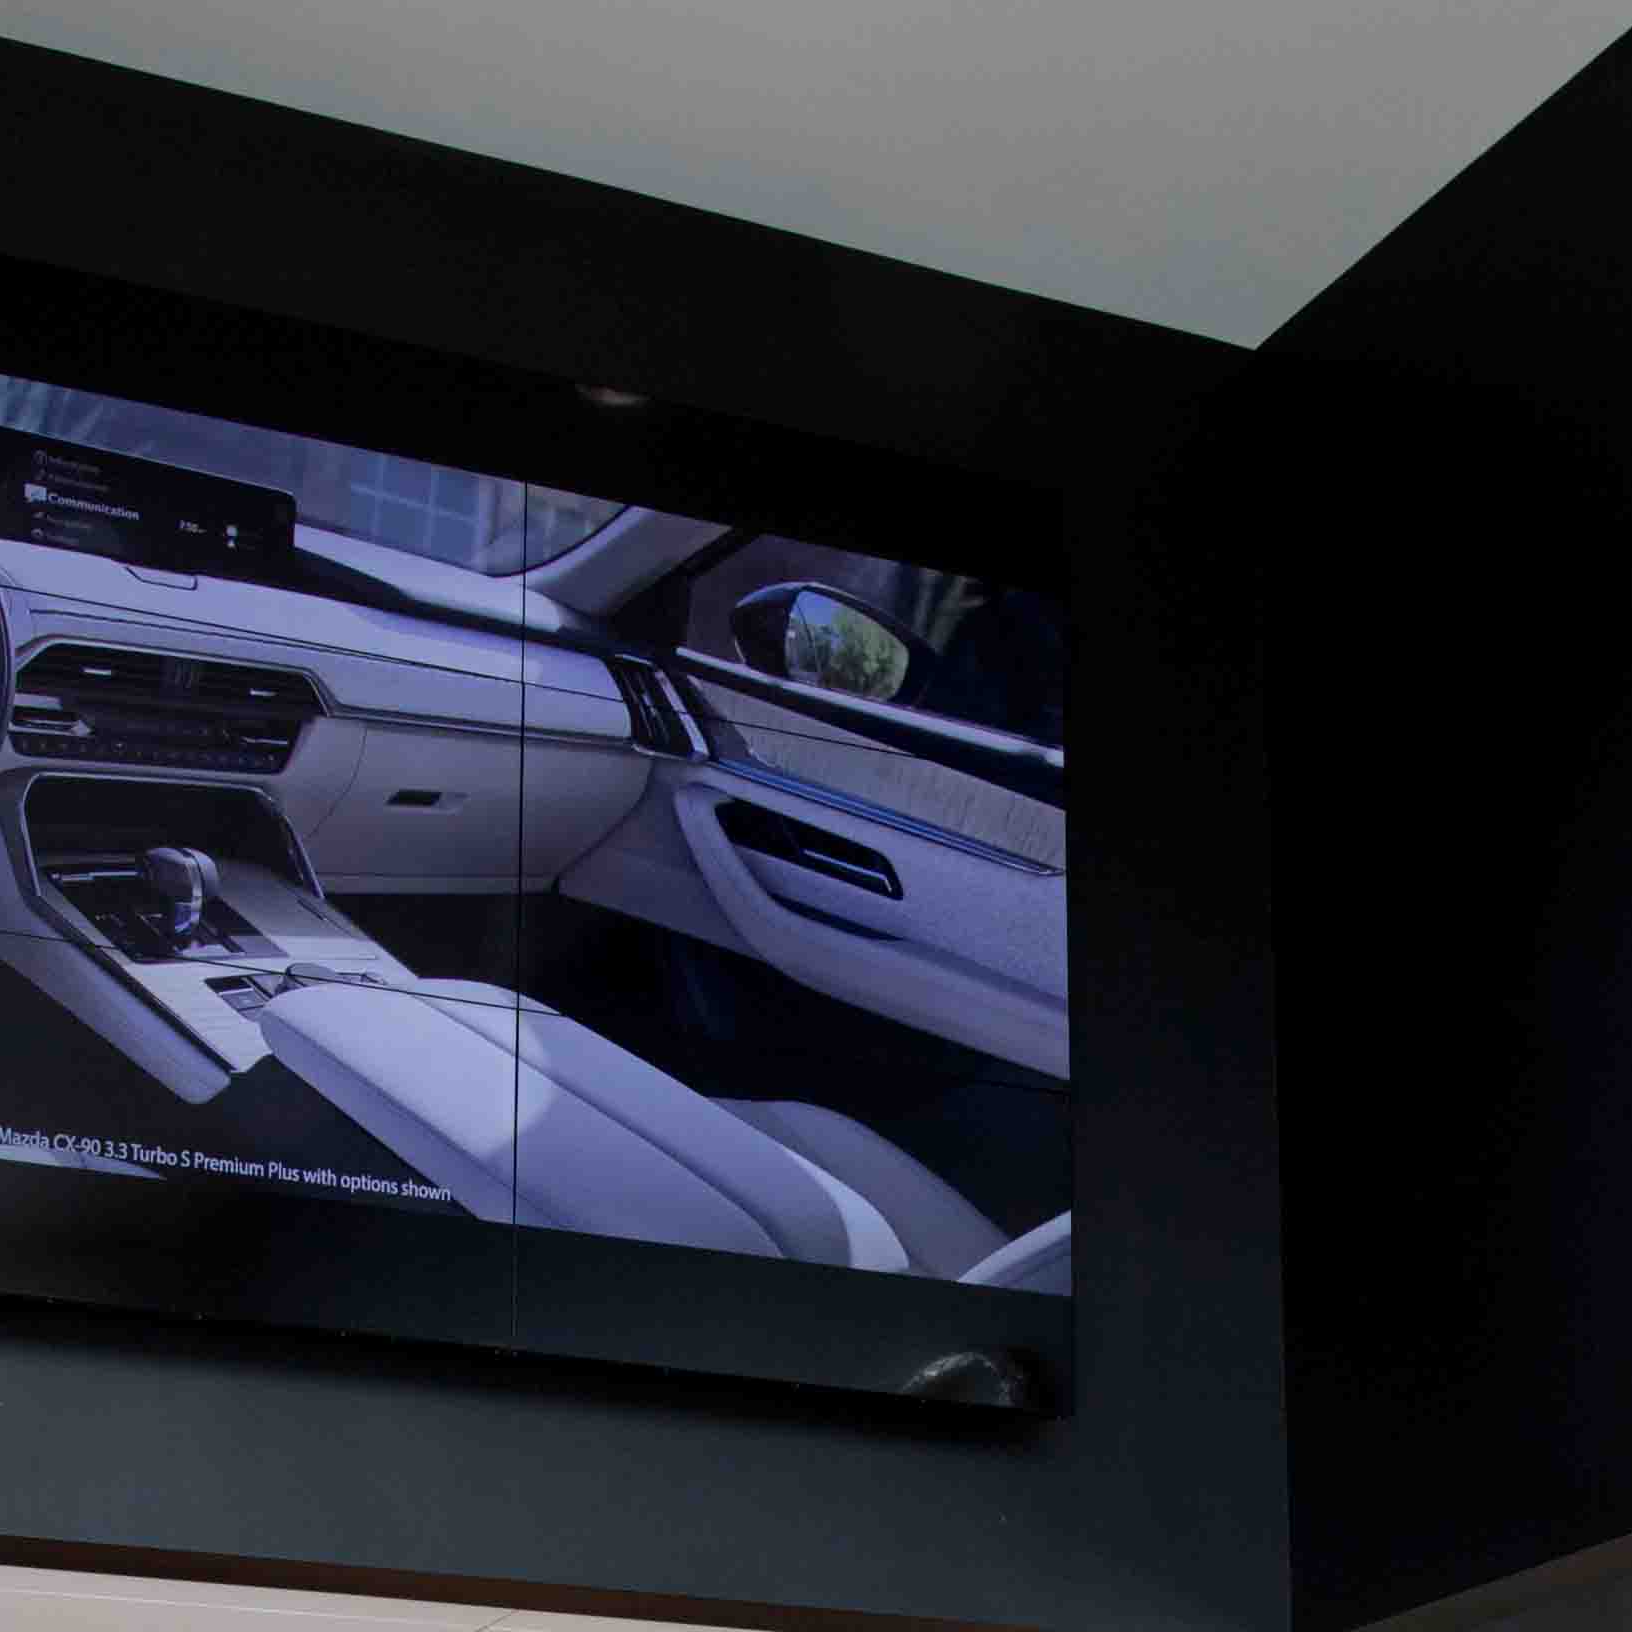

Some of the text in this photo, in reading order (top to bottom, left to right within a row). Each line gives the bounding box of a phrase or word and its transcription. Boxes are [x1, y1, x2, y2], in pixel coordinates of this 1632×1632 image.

[48, 492, 140, 520] Communication
[53, 1133, 102, 1156] CX-90
[104, 1140, 128, 1160] 3.3
[130, 1143, 177, 1167] Turbo
[180, 1150, 191, 1168] S
[194, 1151, 264, 1177] Premium
[268, 1161, 306, 1182] Plus
[303, 1167, 337, 1187] with
[340, 1173, 399, 1196] options
[401, 1180, 452, 1202] shown
